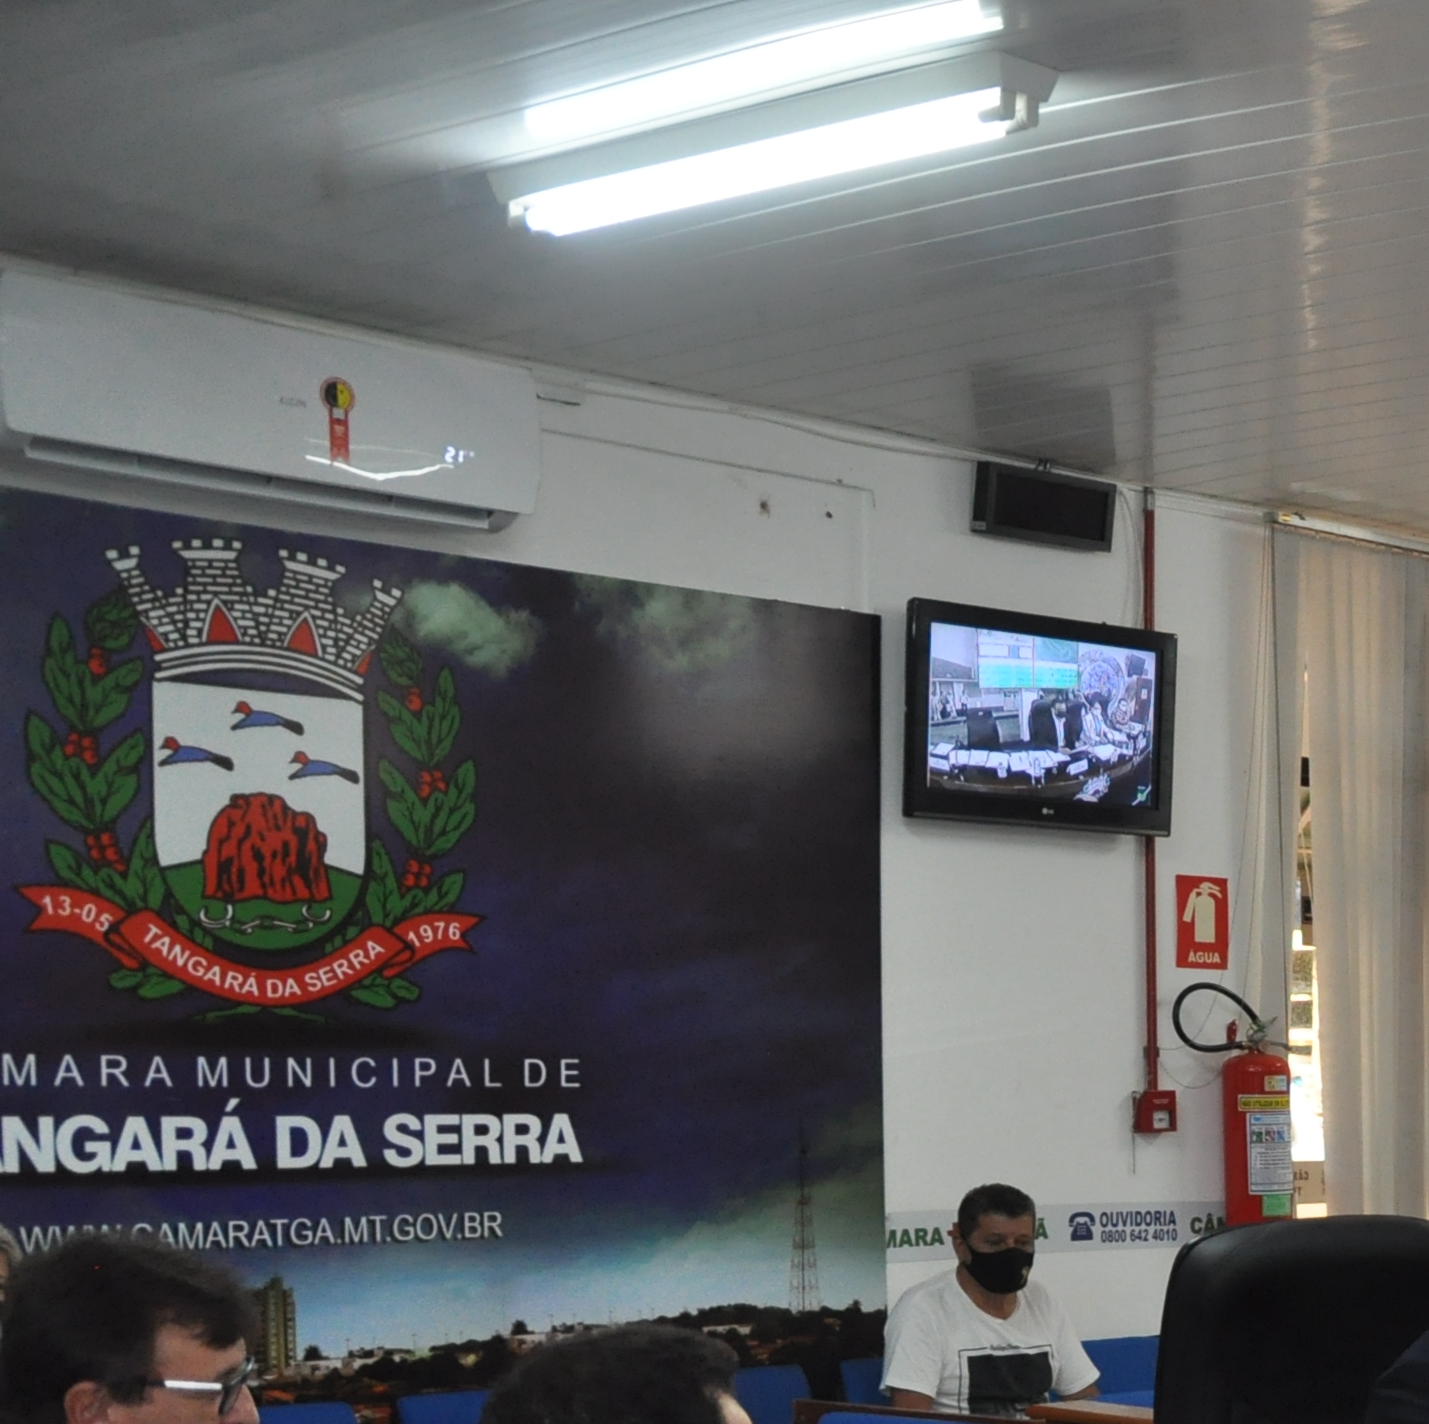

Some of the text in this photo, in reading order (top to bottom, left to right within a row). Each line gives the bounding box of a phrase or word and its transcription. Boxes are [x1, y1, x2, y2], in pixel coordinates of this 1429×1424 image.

[41, 894, 114, 933] 13-05
[406, 921, 461, 949] 1976
[142, 923, 387, 998] TANGARÁ DA SERRA
[1187, 948, 1221, 964] ÁGUA
[196, 1056, 504, 1089] MUNICIPAL
[523, 1058, 581, 1088] DE
[0, 1098, 584, 1174] NGARÁ DA SERRA
[1099, 1210, 1178, 1229] OUVIDORIA
[1100, 1228, 1178, 1244] 0800 642 4010
